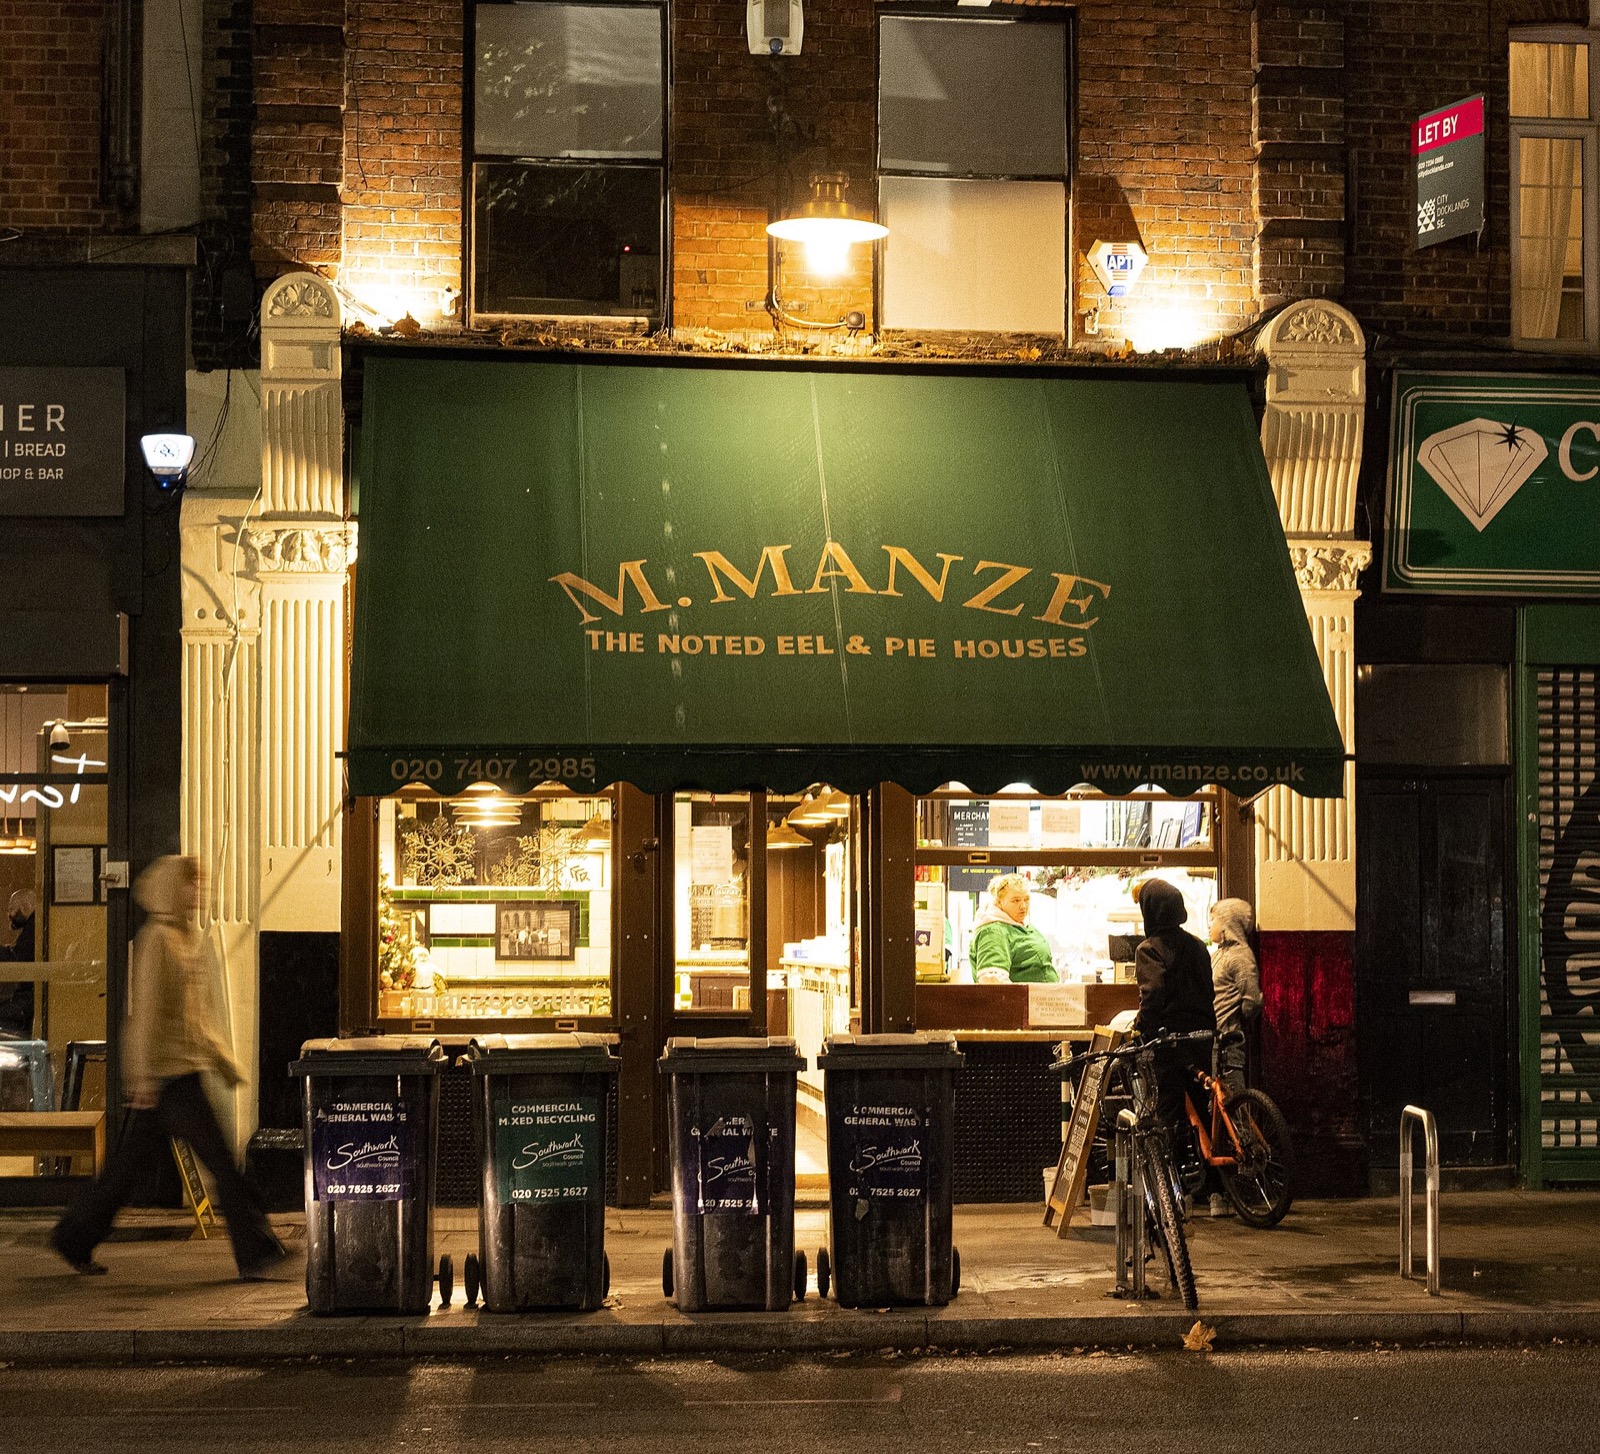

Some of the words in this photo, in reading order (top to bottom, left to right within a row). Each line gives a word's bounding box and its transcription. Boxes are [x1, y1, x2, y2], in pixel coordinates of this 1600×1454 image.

[1418, 120, 1440, 146] LET
[1442, 114, 1458, 138] BY
[1436, 193, 1448, 205] CITY
[1436, 198, 1470, 217] DOCKLANDS
[1108, 255, 1132, 270] APT
[0, 404, 65, 431] ER
[14, 443, 66, 457] BREAD
[0, 468, 21, 480] OP
[25, 468, 34, 480] &
[38, 468, 64, 480] BAR
[585, 630, 644, 653] THE
[658, 634, 766, 656] NOTED
[777, 635, 834, 655] EEL
[845, 635, 872, 655] &
[885, 637, 936, 657] PIE
[953, 638, 1087, 658] HOUSES
[390, 759, 443, 780] 020
[454, 759, 518, 780] 7407
[528, 758, 596, 780] 2985
[1080, 762, 1305, 781] www.manze.co.uk
[511, 1103, 583, 1113] COMMERCIAL
[498, 1117, 534, 1126] MXED
[536, 1114, 596, 1124] RECYCLING
[844, 1117, 892, 1125] GENERAL
[327, 1135, 399, 1169] Southwark
[511, 1133, 584, 1170] Southwark
[849, 1139, 921, 1171] Southwark
[327, 1184, 346, 1194] 020
[348, 1184, 373, 1194] 7525
[375, 1184, 401, 1193] 2627
[512, 1189, 531, 1199] 020
[534, 1188, 560, 1198] 7525
[563, 1186, 588, 1196] 2627
[870, 1187, 894, 1196] 7525
[897, 1188, 921, 1197] 2627
[718, 1199, 743, 1208] 7525
